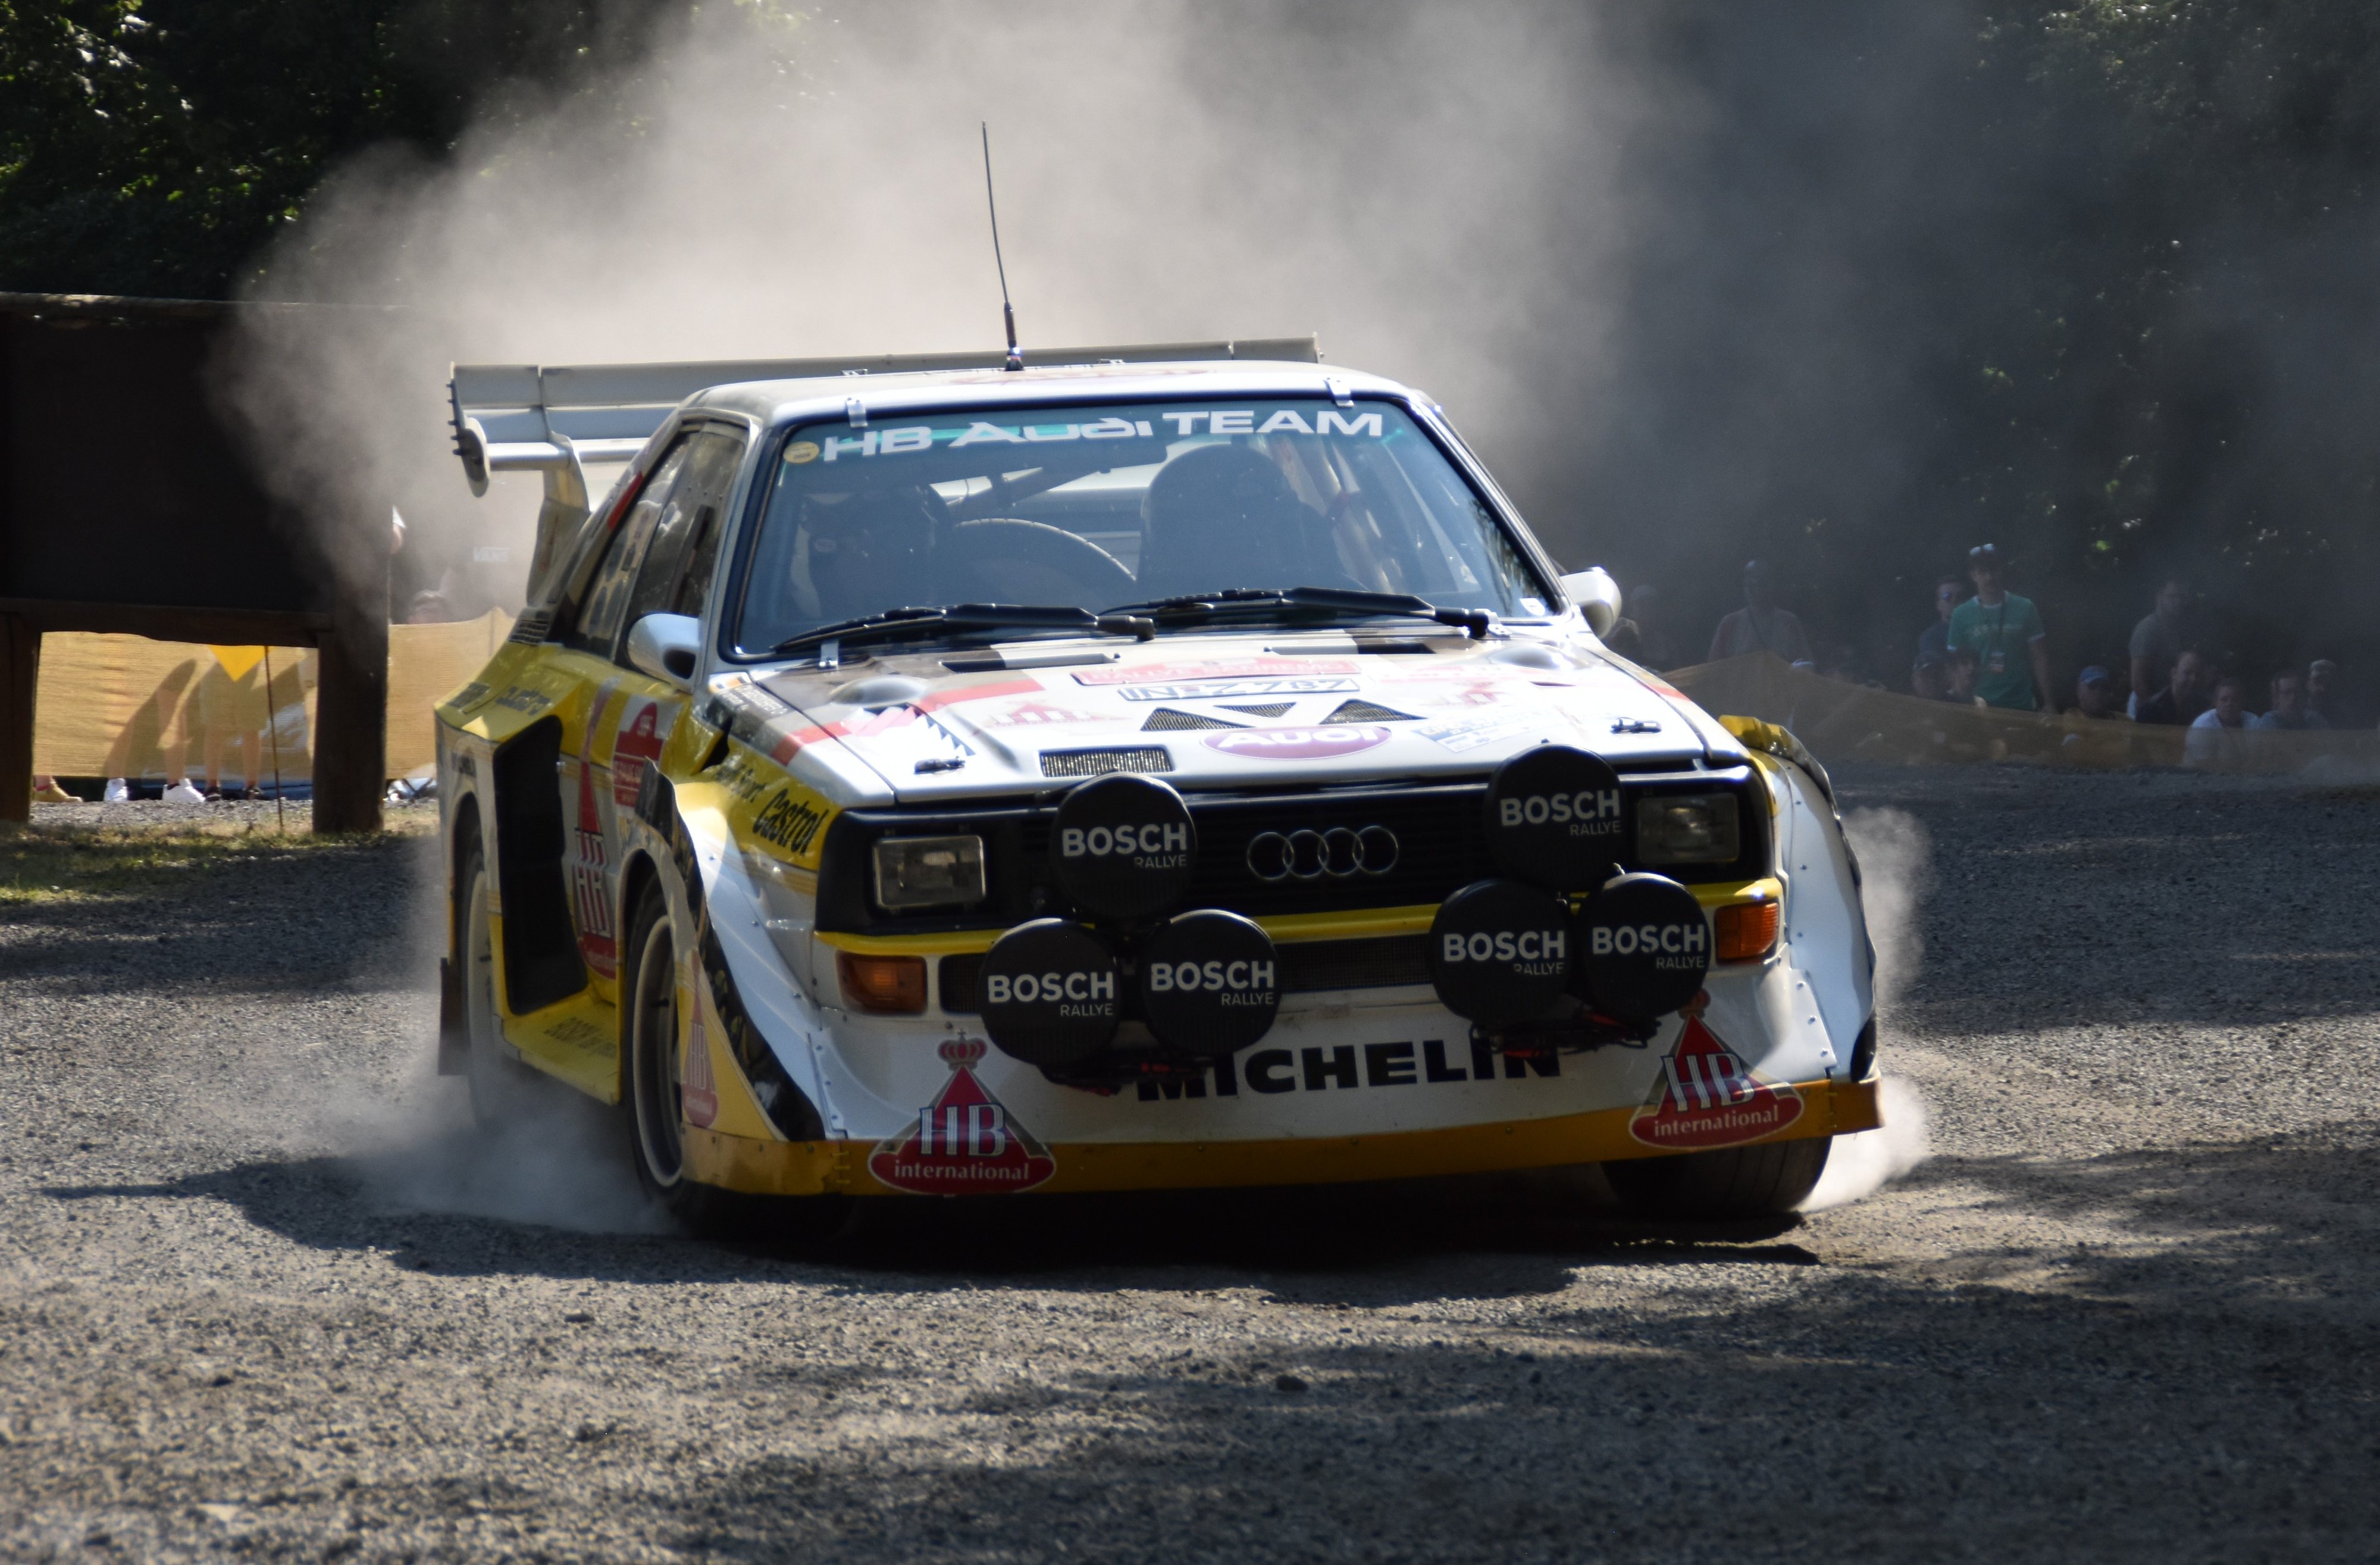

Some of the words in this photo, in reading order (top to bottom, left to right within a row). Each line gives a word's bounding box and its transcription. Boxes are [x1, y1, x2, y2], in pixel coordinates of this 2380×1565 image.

[823, 425, 932, 462] HB
[1163, 409, 1383, 437] TEAM
[752, 788, 829, 856] Castrol
[1500, 789, 1621, 827] BOSCH
[1062, 822, 1187, 857] BOSCH
[1570, 821, 1622, 837] RALLYE
[1134, 855, 1187, 869] RALLYE
[1443, 931, 1565, 962] BOSCH
[1592, 924, 1705, 955] BOSCH
[1151, 960, 1274, 991] BOSCH
[1514, 962, 1565, 975] RALLYE
[1656, 956, 1705, 969] RALLYE
[988, 971, 1114, 1003] BOSCH
[1221, 992, 1274, 1006] RALLYE
[1060, 1003, 1114, 1017] RALLYE
[1661, 1051, 1755, 1112] HB
[920, 1103, 1007, 1157] HB
[1655, 1104, 1779, 1137] international
[894, 1159, 1029, 1180] international
